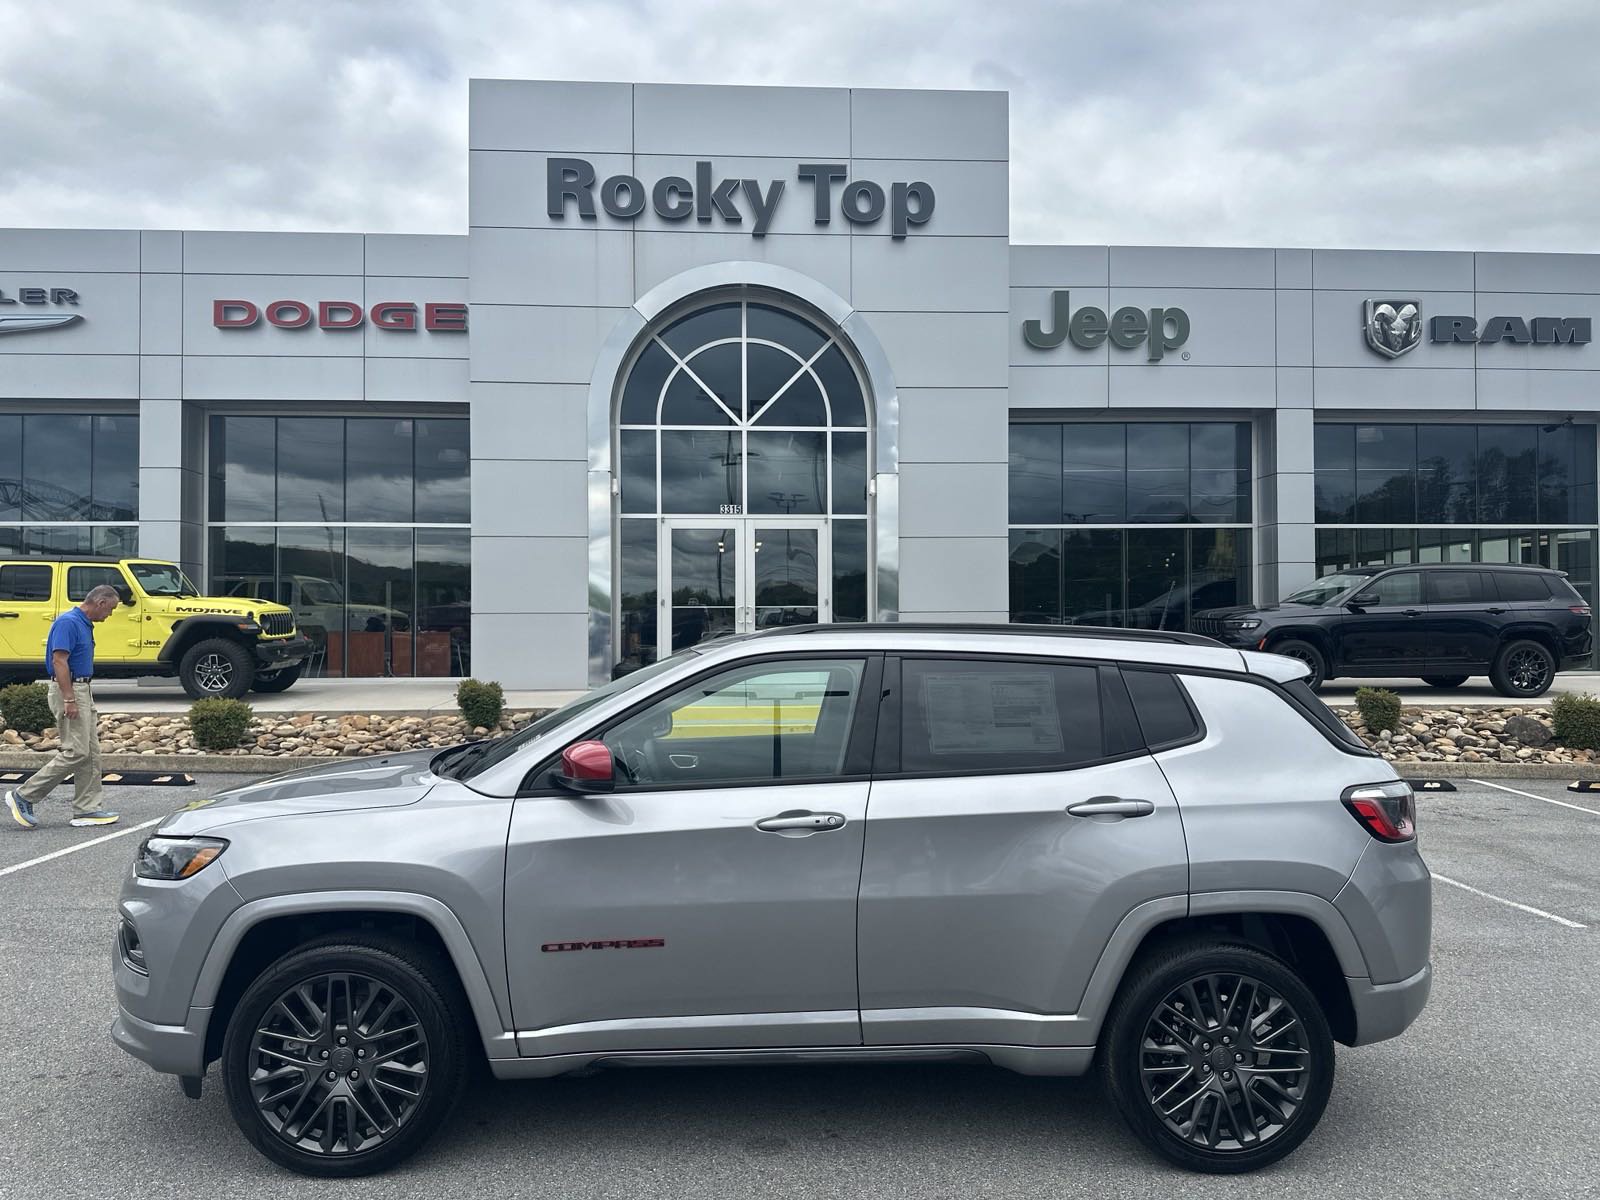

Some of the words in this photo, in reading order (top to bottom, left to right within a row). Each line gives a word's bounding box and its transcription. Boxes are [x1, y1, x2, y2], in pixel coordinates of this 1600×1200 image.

[547, 157, 786, 237] Rocky
[798, 163, 936, 241] Top
[213, 299, 470, 332] DODGE
[1023, 290, 1190, 362] Jeep
[1430, 314, 1592, 345] RAM
[720, 504, 742, 514] 3315
[175, 606, 243, 615] MOJAVE
[541, 939, 665, 952] COMPASS
